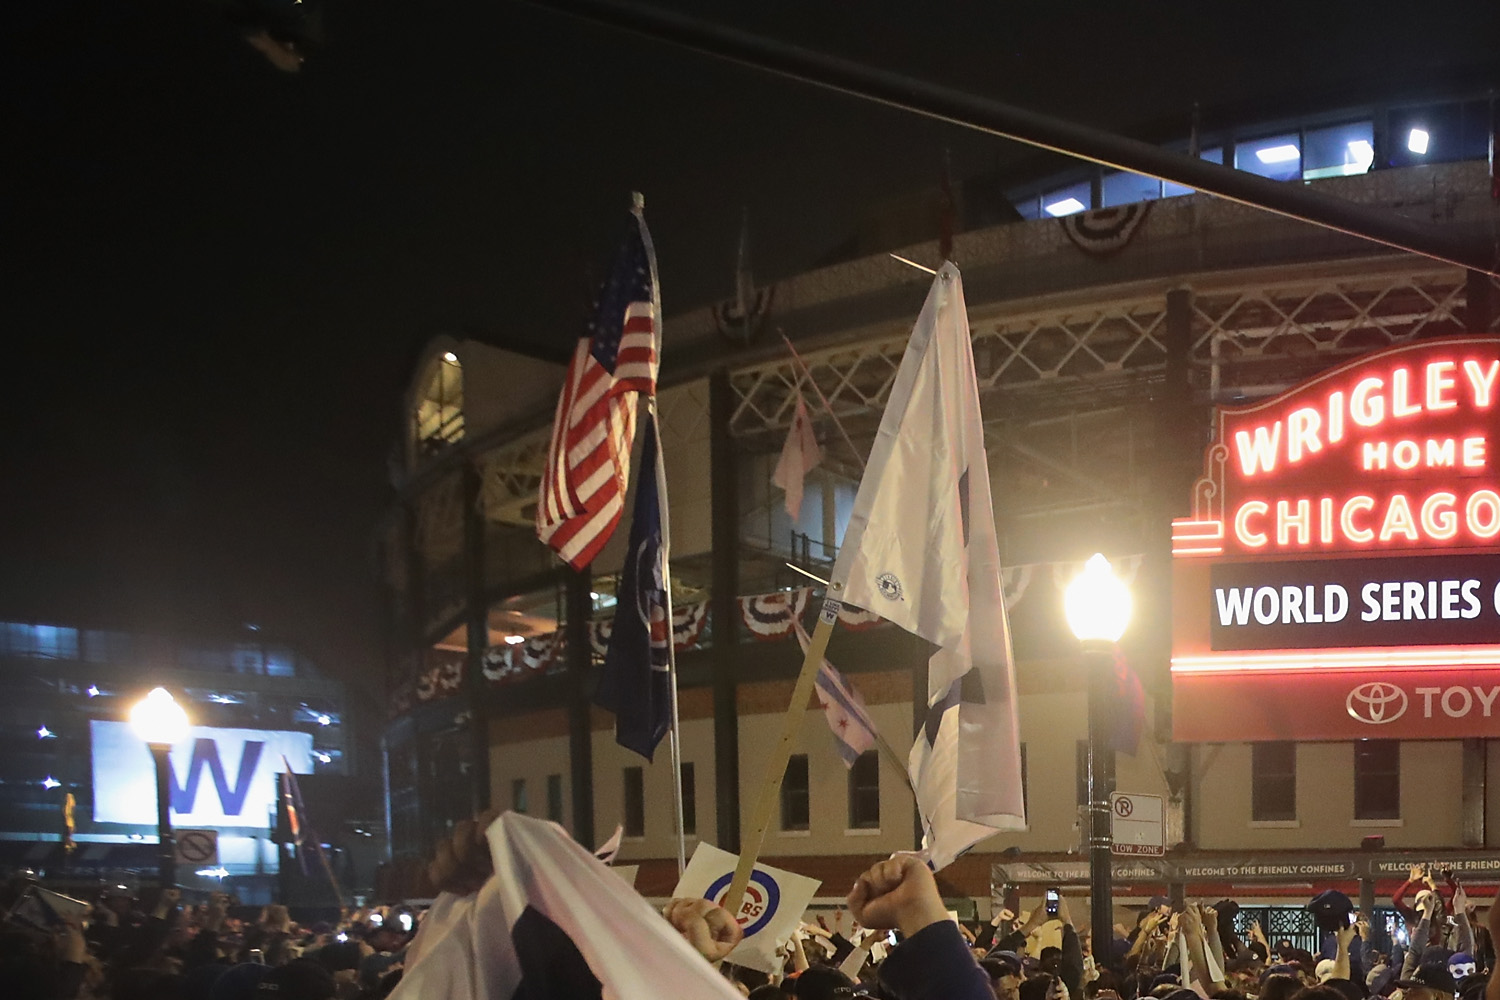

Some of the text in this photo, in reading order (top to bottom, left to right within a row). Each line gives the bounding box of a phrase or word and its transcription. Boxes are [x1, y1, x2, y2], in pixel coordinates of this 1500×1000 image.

[1234, 359, 1500, 477] WRIGLEY
[1362, 436, 1487, 470] HOME
[1215, 582, 1349, 626] WORLD
[1361, 577, 1481, 622] SERIES
[170, 737, 265, 816] W
[1115, 844, 1159, 854] TOW ZONE
[1053, 870, 1063, 878] TO
[1065, 870, 1079, 878] THE
[1117, 868, 1155, 877] CONFINES
[1185, 864, 1345, 876] WELCOME TO THE FRIENDLY CONFINES
